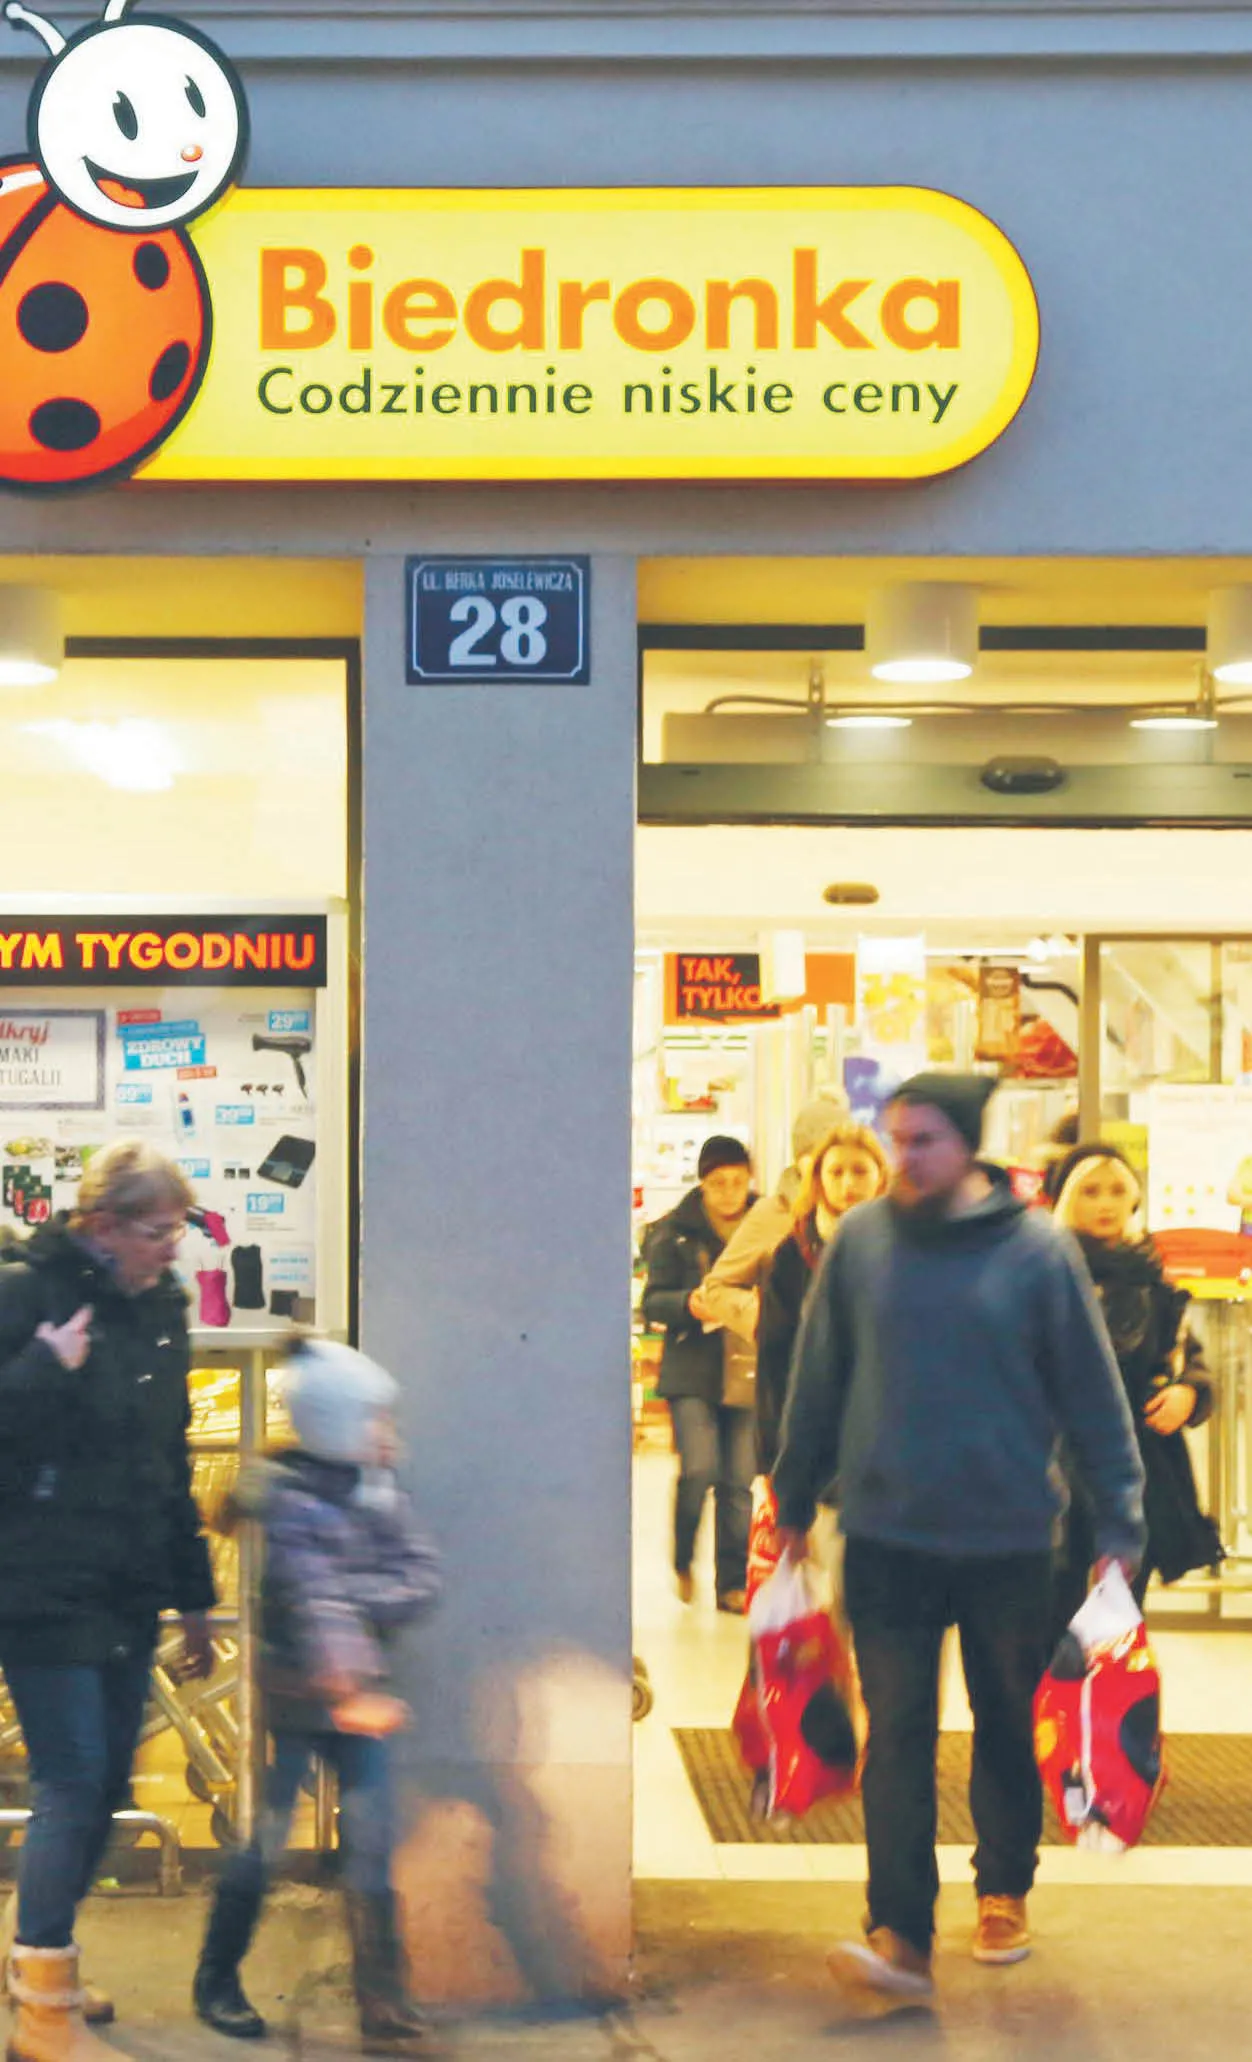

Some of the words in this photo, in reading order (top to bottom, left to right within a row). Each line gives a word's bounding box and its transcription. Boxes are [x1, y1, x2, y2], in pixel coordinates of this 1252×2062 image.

[259, 245, 961, 351] Biedronka
[257, 367, 593, 415] Codziennie
[624, 367, 794, 415] niskie
[824, 382, 960, 424] ceny
[449, 595, 548, 667] 28
[0, 932, 63, 969] YM
[75, 931, 316, 970] TYGODNIU
[681, 957, 742, 985] TAK,
